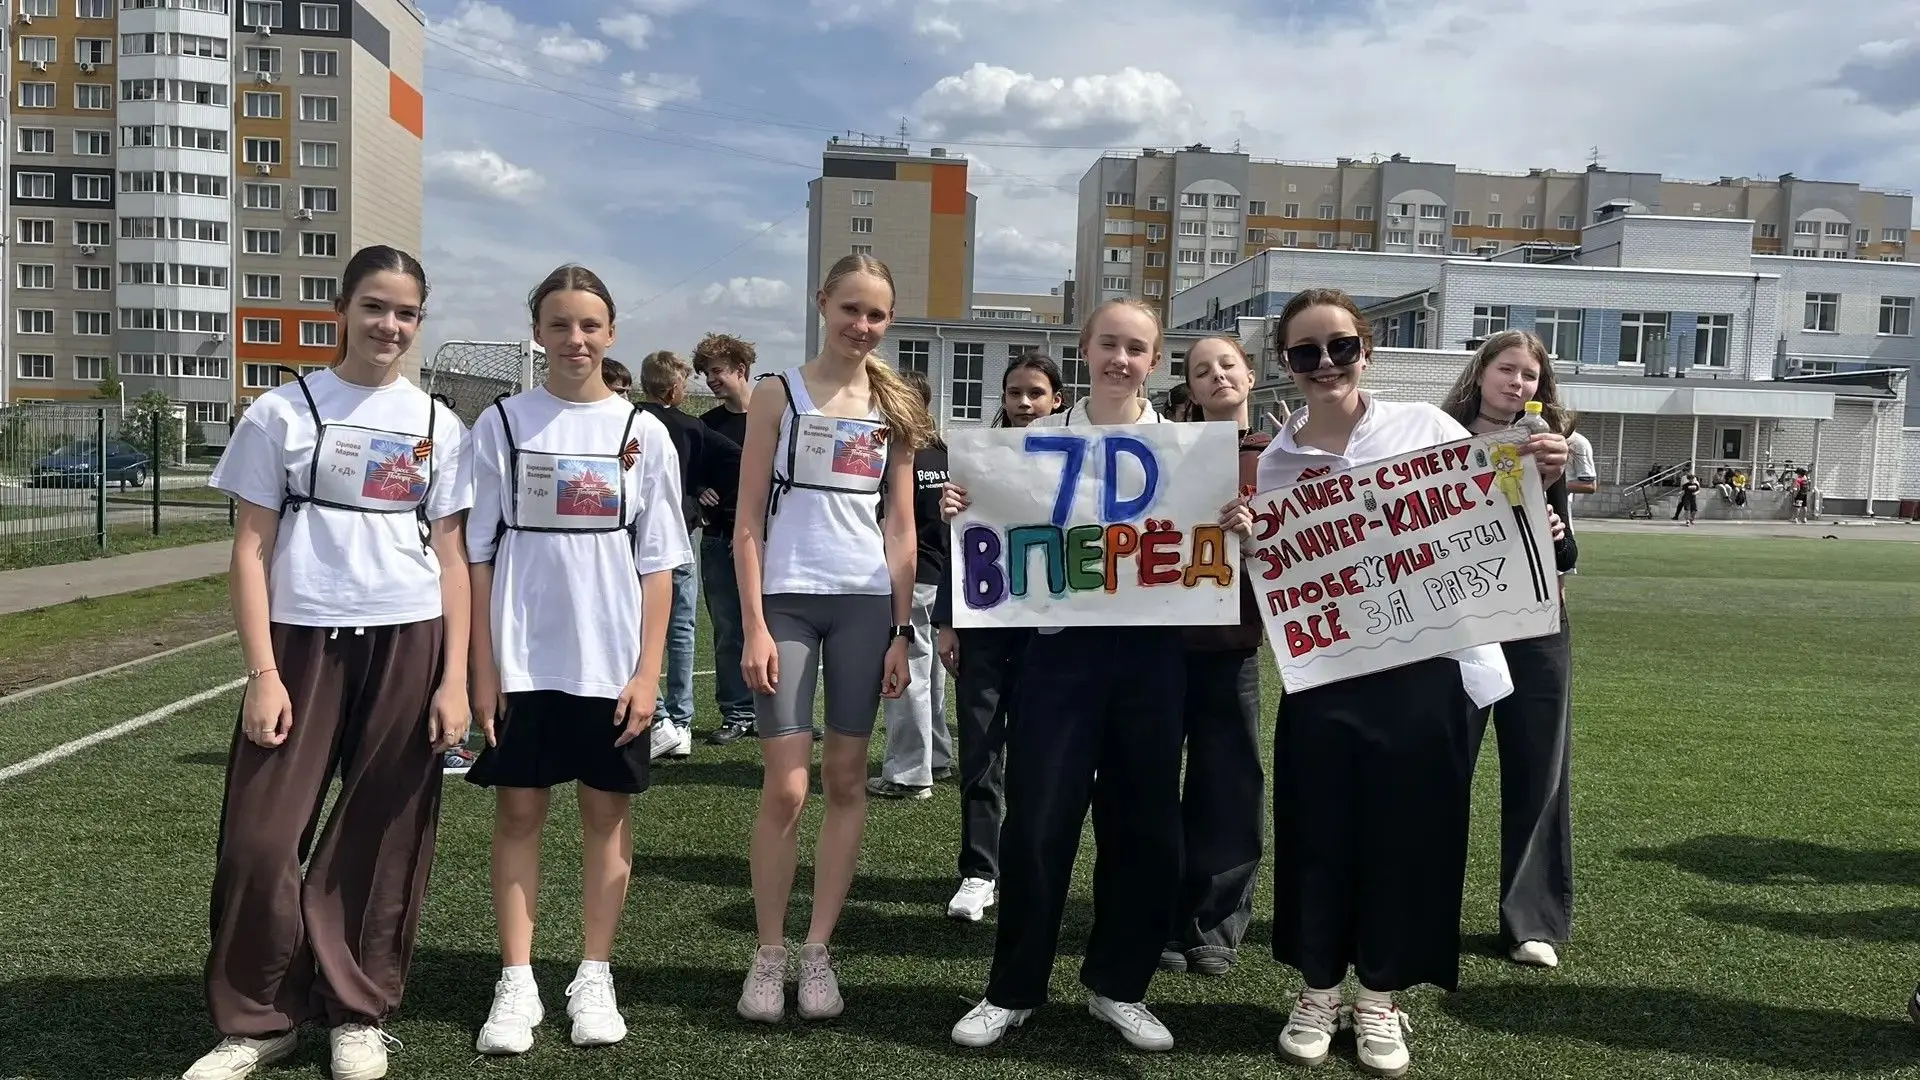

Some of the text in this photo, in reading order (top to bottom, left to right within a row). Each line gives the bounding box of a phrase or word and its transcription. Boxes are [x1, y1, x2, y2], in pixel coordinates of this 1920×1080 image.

[335, 448, 359, 457] Мария
[330, 464, 337, 472] 7
[917, 470, 940, 484] Верь
[940, 470, 946, 479] в
[527, 487, 532, 495] 7
[963, 519, 1234, 609] ВПЕРЁД
[1284, 557, 1508, 658] ВСЁ ЗА РАЗ!
